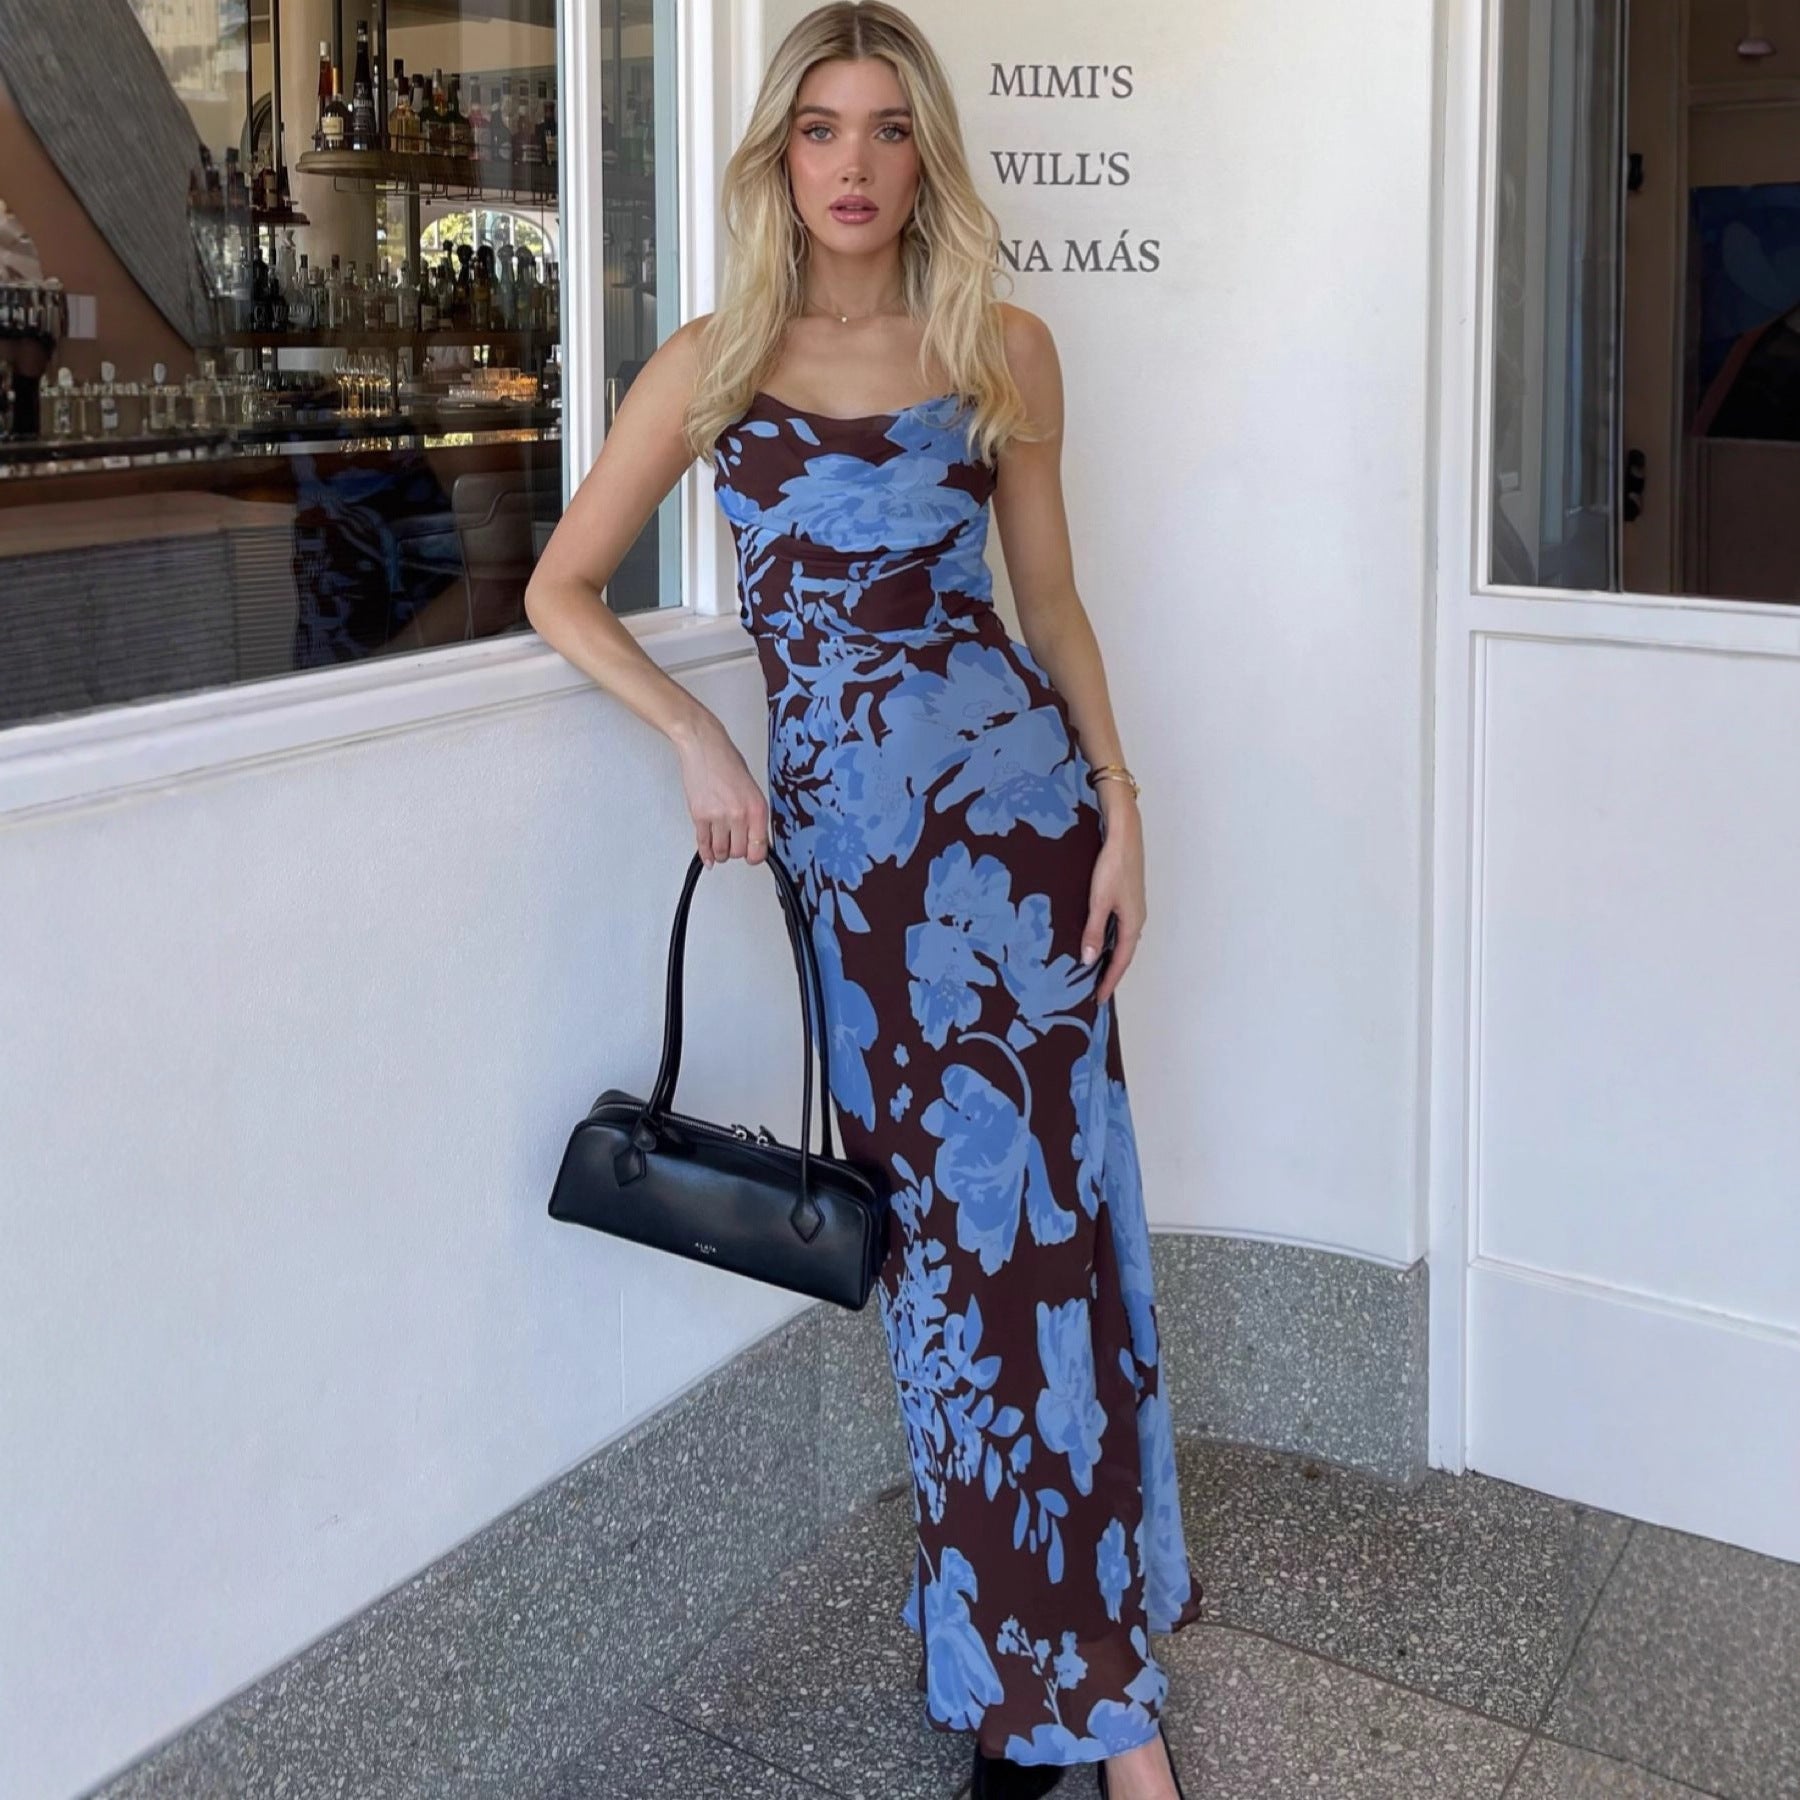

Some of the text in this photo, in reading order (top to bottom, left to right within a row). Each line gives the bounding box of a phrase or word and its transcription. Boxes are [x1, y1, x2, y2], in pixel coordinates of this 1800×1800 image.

[989, 62, 1133, 99] MIMI'S
[990, 151, 1130, 186] WILL'S
[986, 229, 1160, 273] NA MÁS
